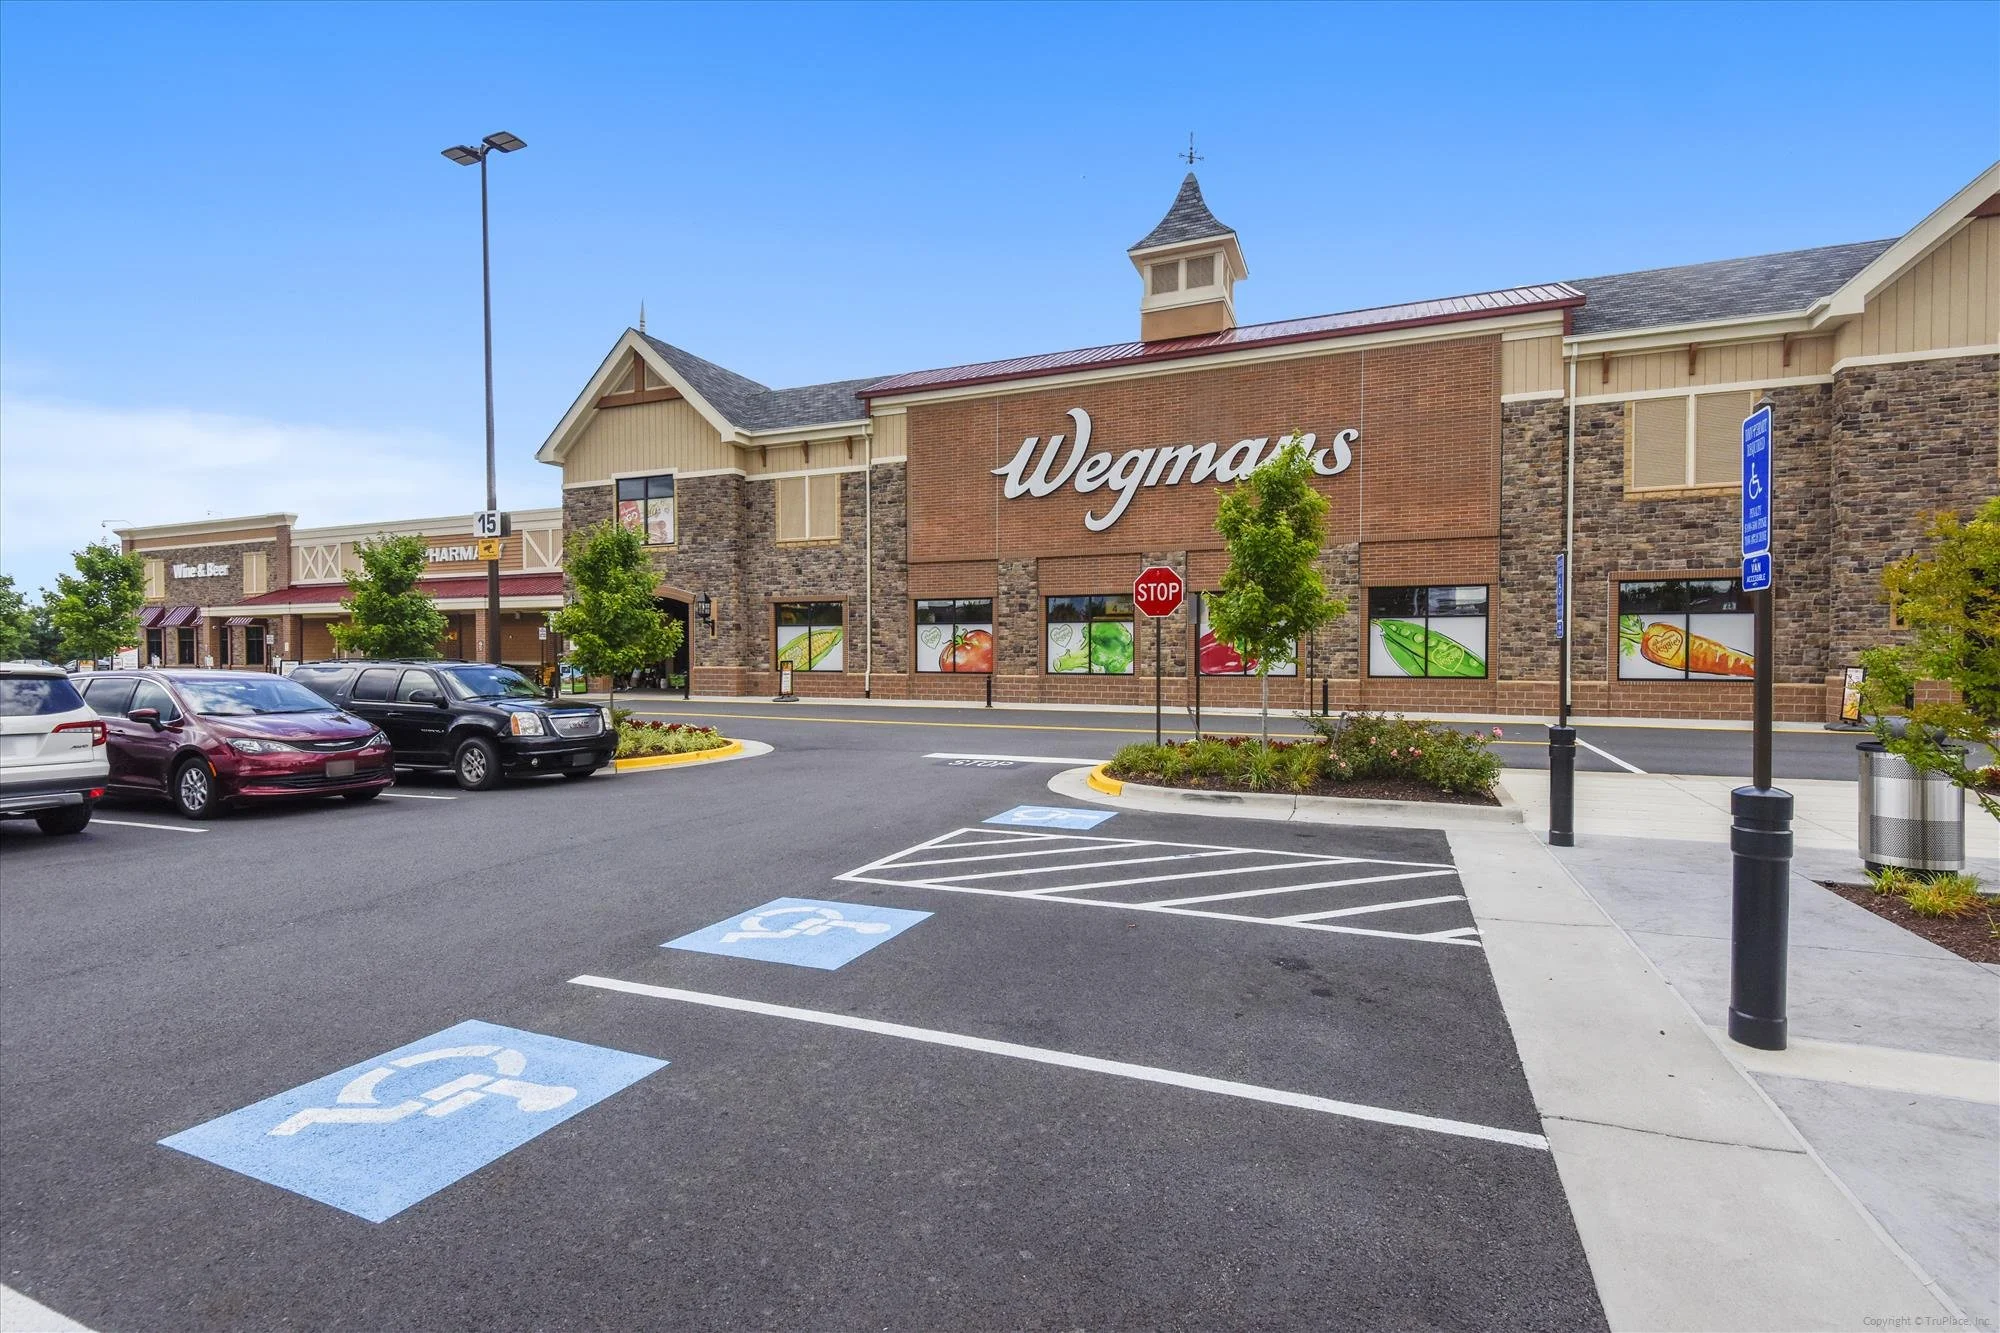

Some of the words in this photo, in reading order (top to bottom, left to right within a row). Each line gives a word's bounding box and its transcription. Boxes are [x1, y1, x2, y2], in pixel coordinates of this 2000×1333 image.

[990, 407, 1359, 532] Wegmans
[478, 513, 497, 534] 15
[173, 563, 197, 579] Wine
[197, 563, 207, 578] &
[206, 562, 230, 577] Beer
[1137, 582, 1180, 602] STOP
